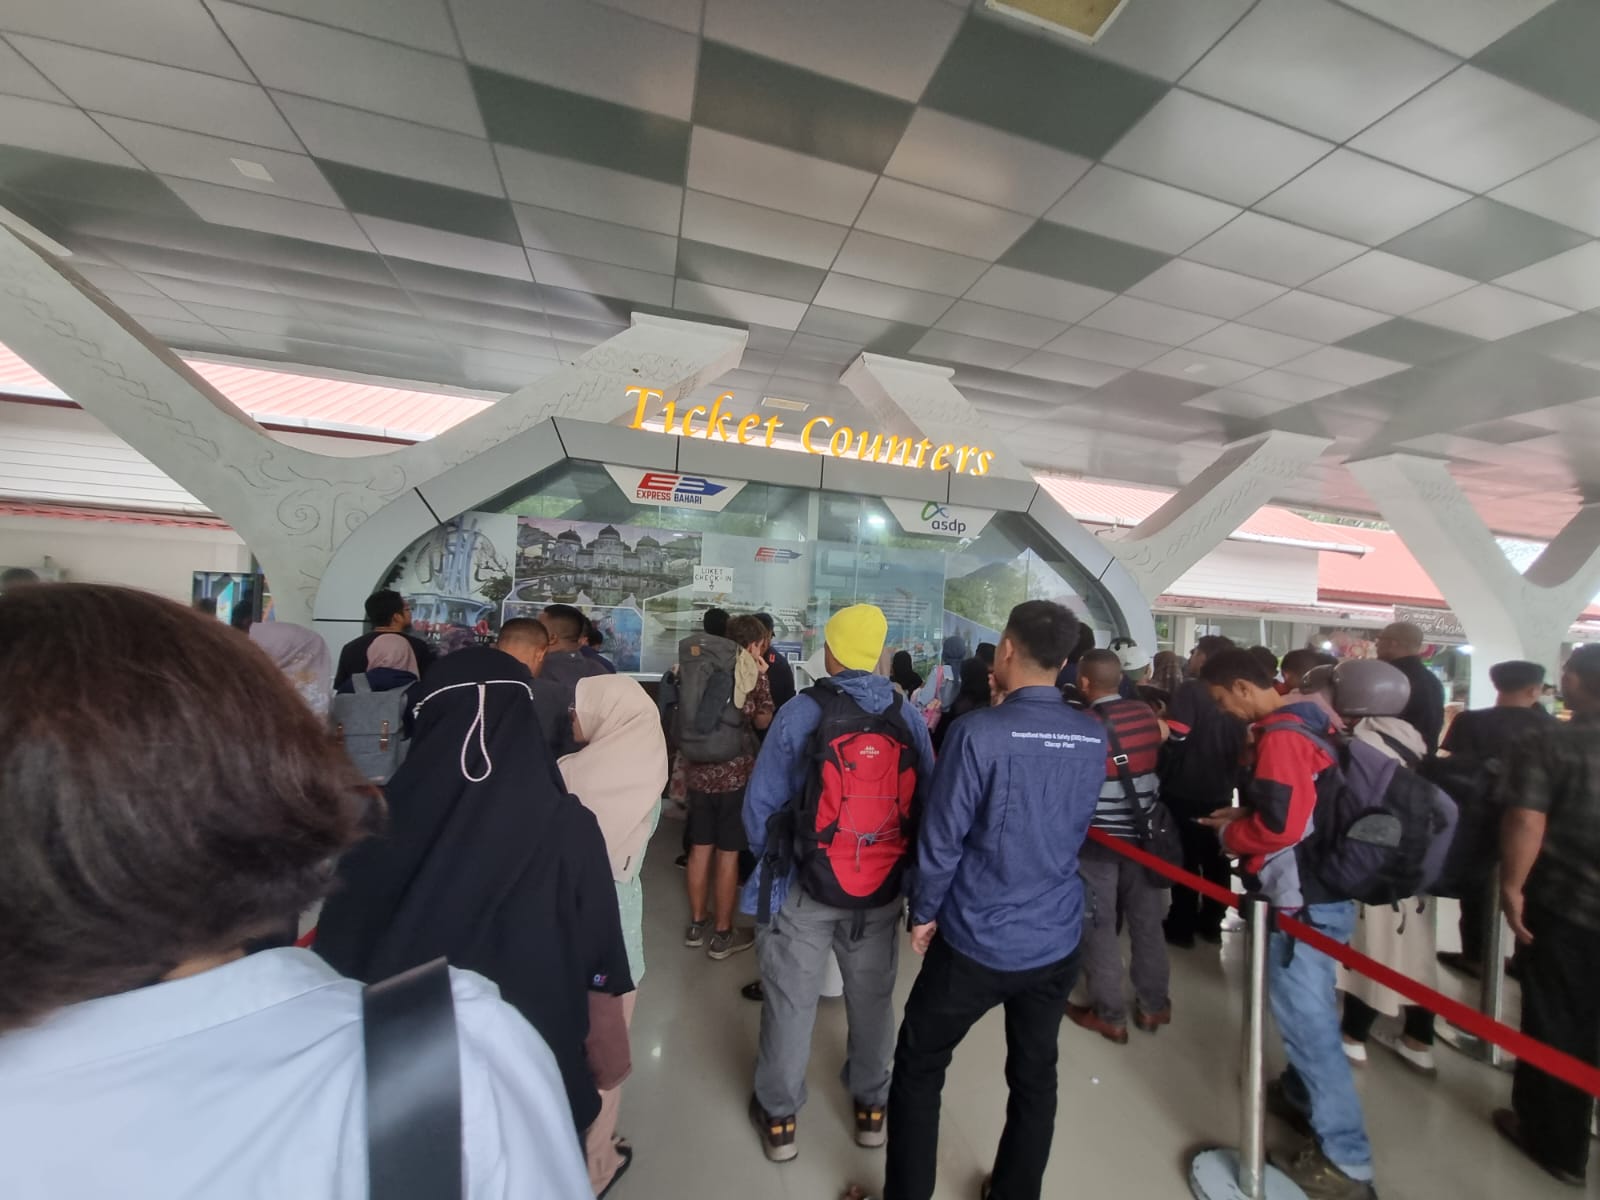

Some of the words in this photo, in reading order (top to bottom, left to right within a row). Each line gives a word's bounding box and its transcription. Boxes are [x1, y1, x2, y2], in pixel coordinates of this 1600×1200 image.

[625, 385, 784, 447] Ticket
[800, 416, 995, 476] Counters
[636, 489, 671, 501] EXPRESS
[674, 493, 702, 504] BAHARI
[931, 519, 966, 535] asdp
